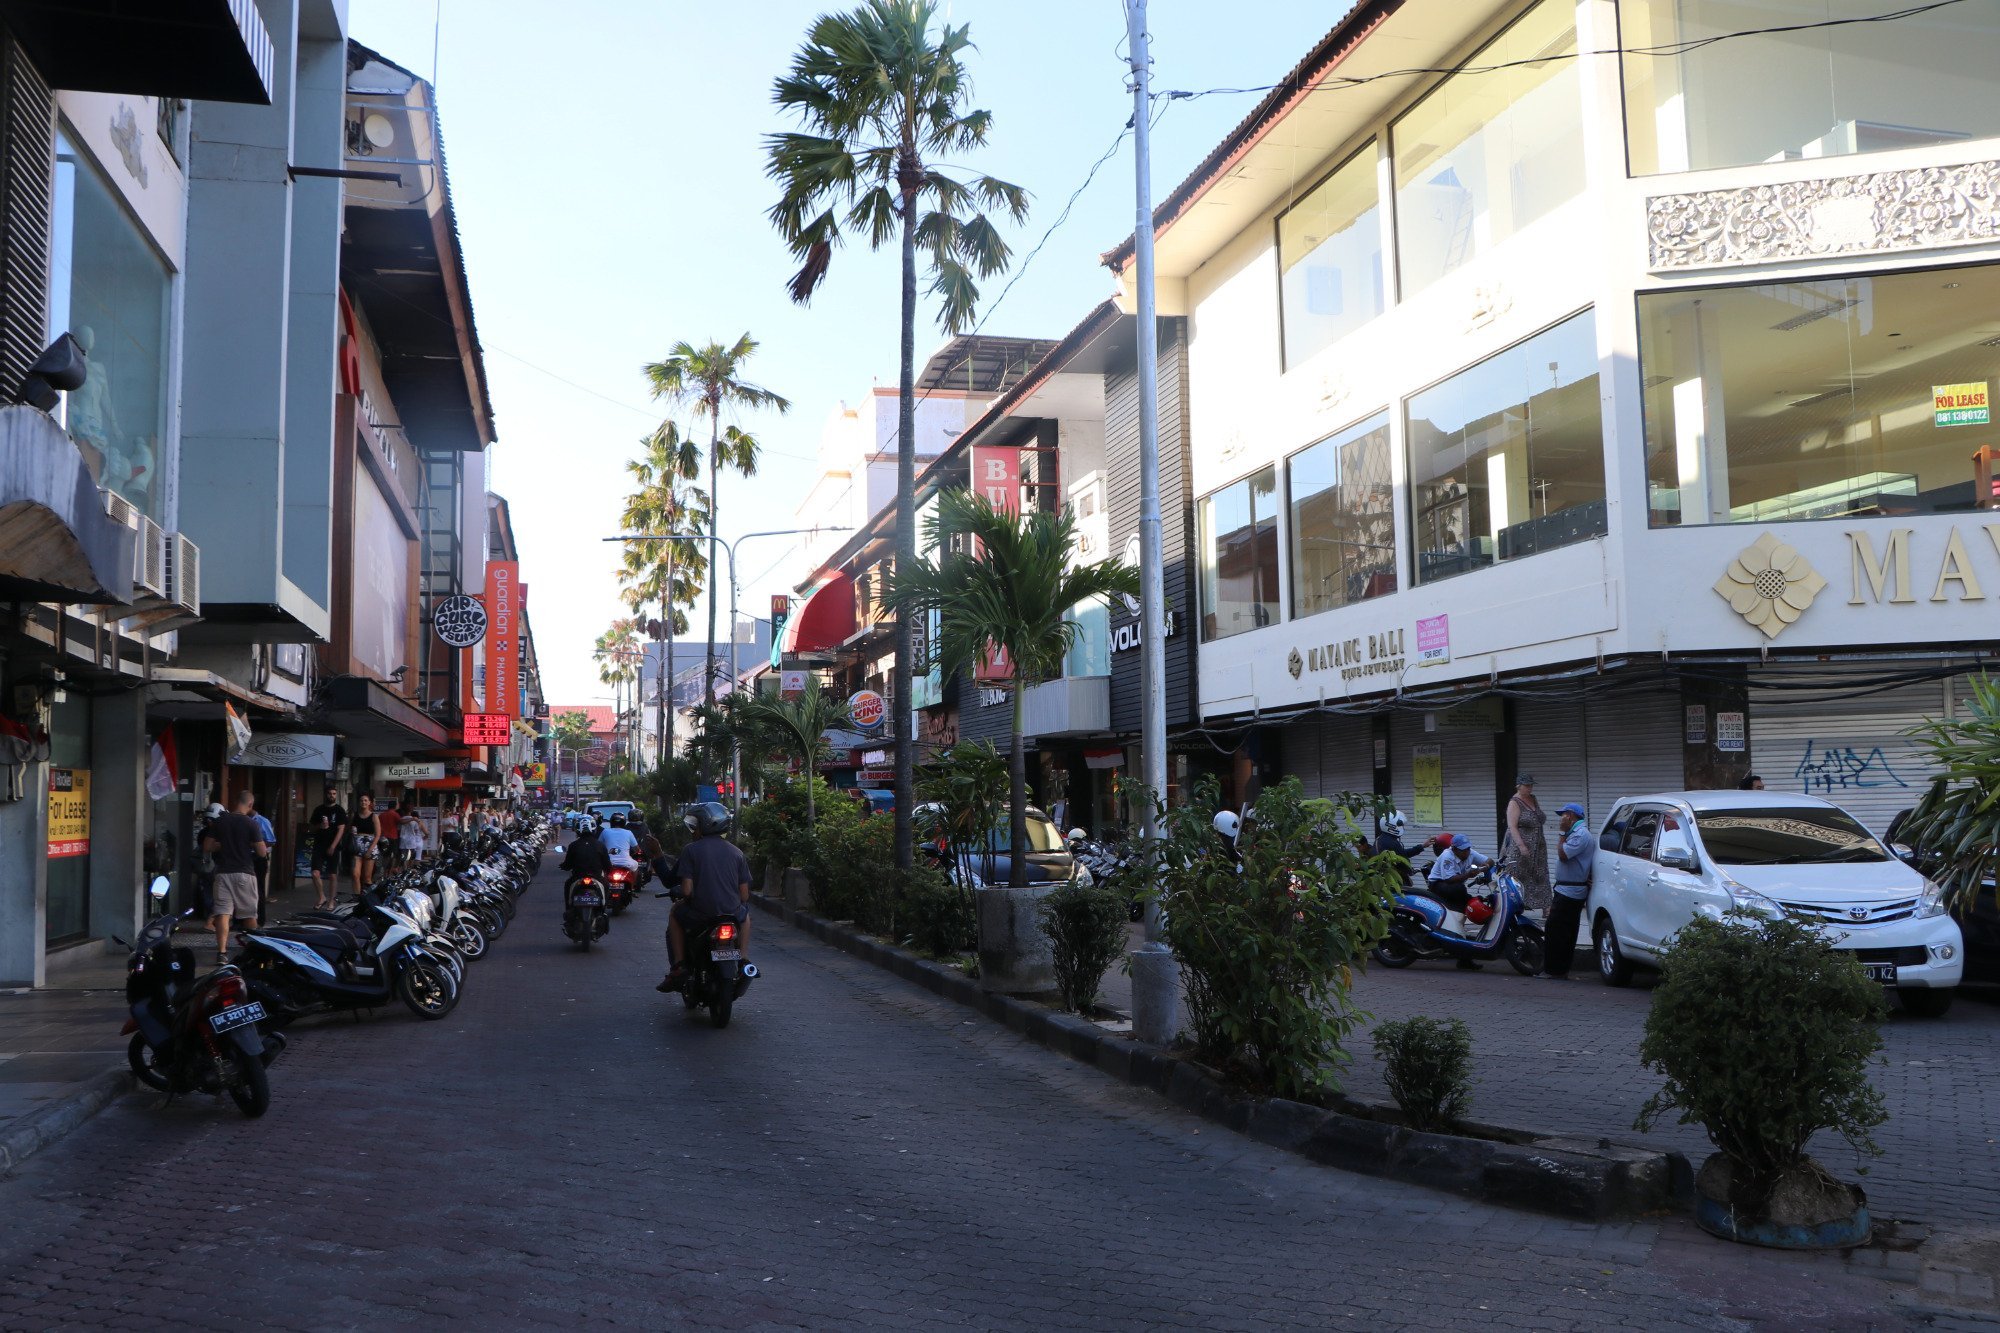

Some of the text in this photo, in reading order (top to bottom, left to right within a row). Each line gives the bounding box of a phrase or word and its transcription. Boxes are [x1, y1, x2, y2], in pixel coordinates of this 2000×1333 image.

[1936, 393, 1985, 408] FOR LEASE
[438, 596, 470, 614] RIP
[493, 569, 511, 635] guardian
[436, 611, 486, 626] CURL
[1308, 628, 1405, 672] MAYANG BALI
[1424, 649, 1442, 659] FOR RENT
[496, 657, 506, 712] PHARMACY
[853, 698, 881, 709] BURGER
[854, 706, 883, 718] KING
[1719, 714, 1742, 722] YUNITA
[266, 745, 297, 756] VERSUS
[1719, 740, 1743, 748] FOR RENT
[388, 766, 430, 778] Kapal-Laut
[64, 797, 86, 820] Lease
[1881, 967, 1894, 980] KZ
[214, 1015, 227, 1026] DK
[227, 1009, 246, 1021] 3217
